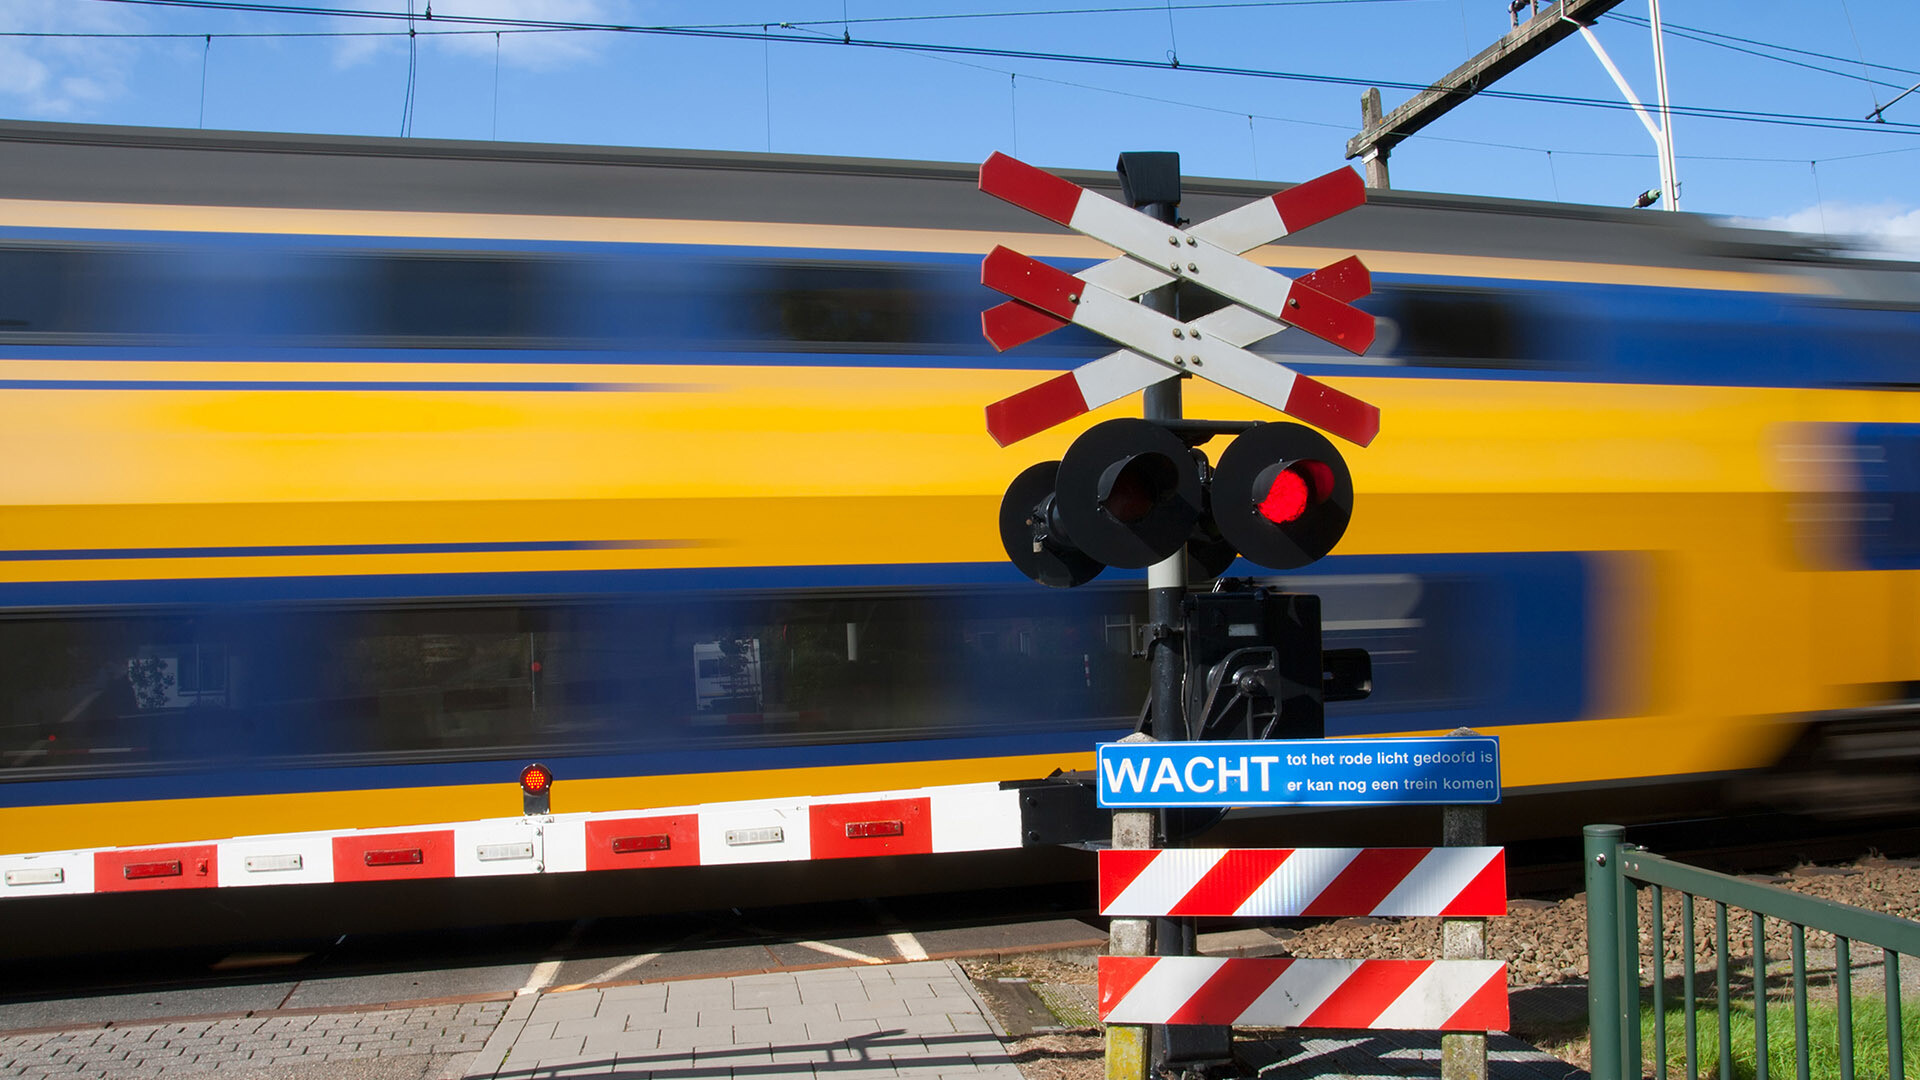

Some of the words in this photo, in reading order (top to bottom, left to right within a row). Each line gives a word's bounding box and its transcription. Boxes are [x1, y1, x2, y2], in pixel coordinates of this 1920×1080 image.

[1287, 754, 1307, 766] tot
[1311, 753, 1334, 765] het
[1339, 752, 1372, 765] rode
[1377, 751, 1408, 764] licht
[1413, 751, 1475, 767] gedoofd
[1481, 752, 1493, 762] is
[1103, 756, 1279, 793] WACHT
[1287, 780, 1302, 790] er
[1307, 778, 1333, 790] kan
[1339, 779, 1366, 793] nog
[1372, 779, 1398, 790] een
[1404, 777, 1438, 790] trein
[1444, 777, 1494, 789] komen
